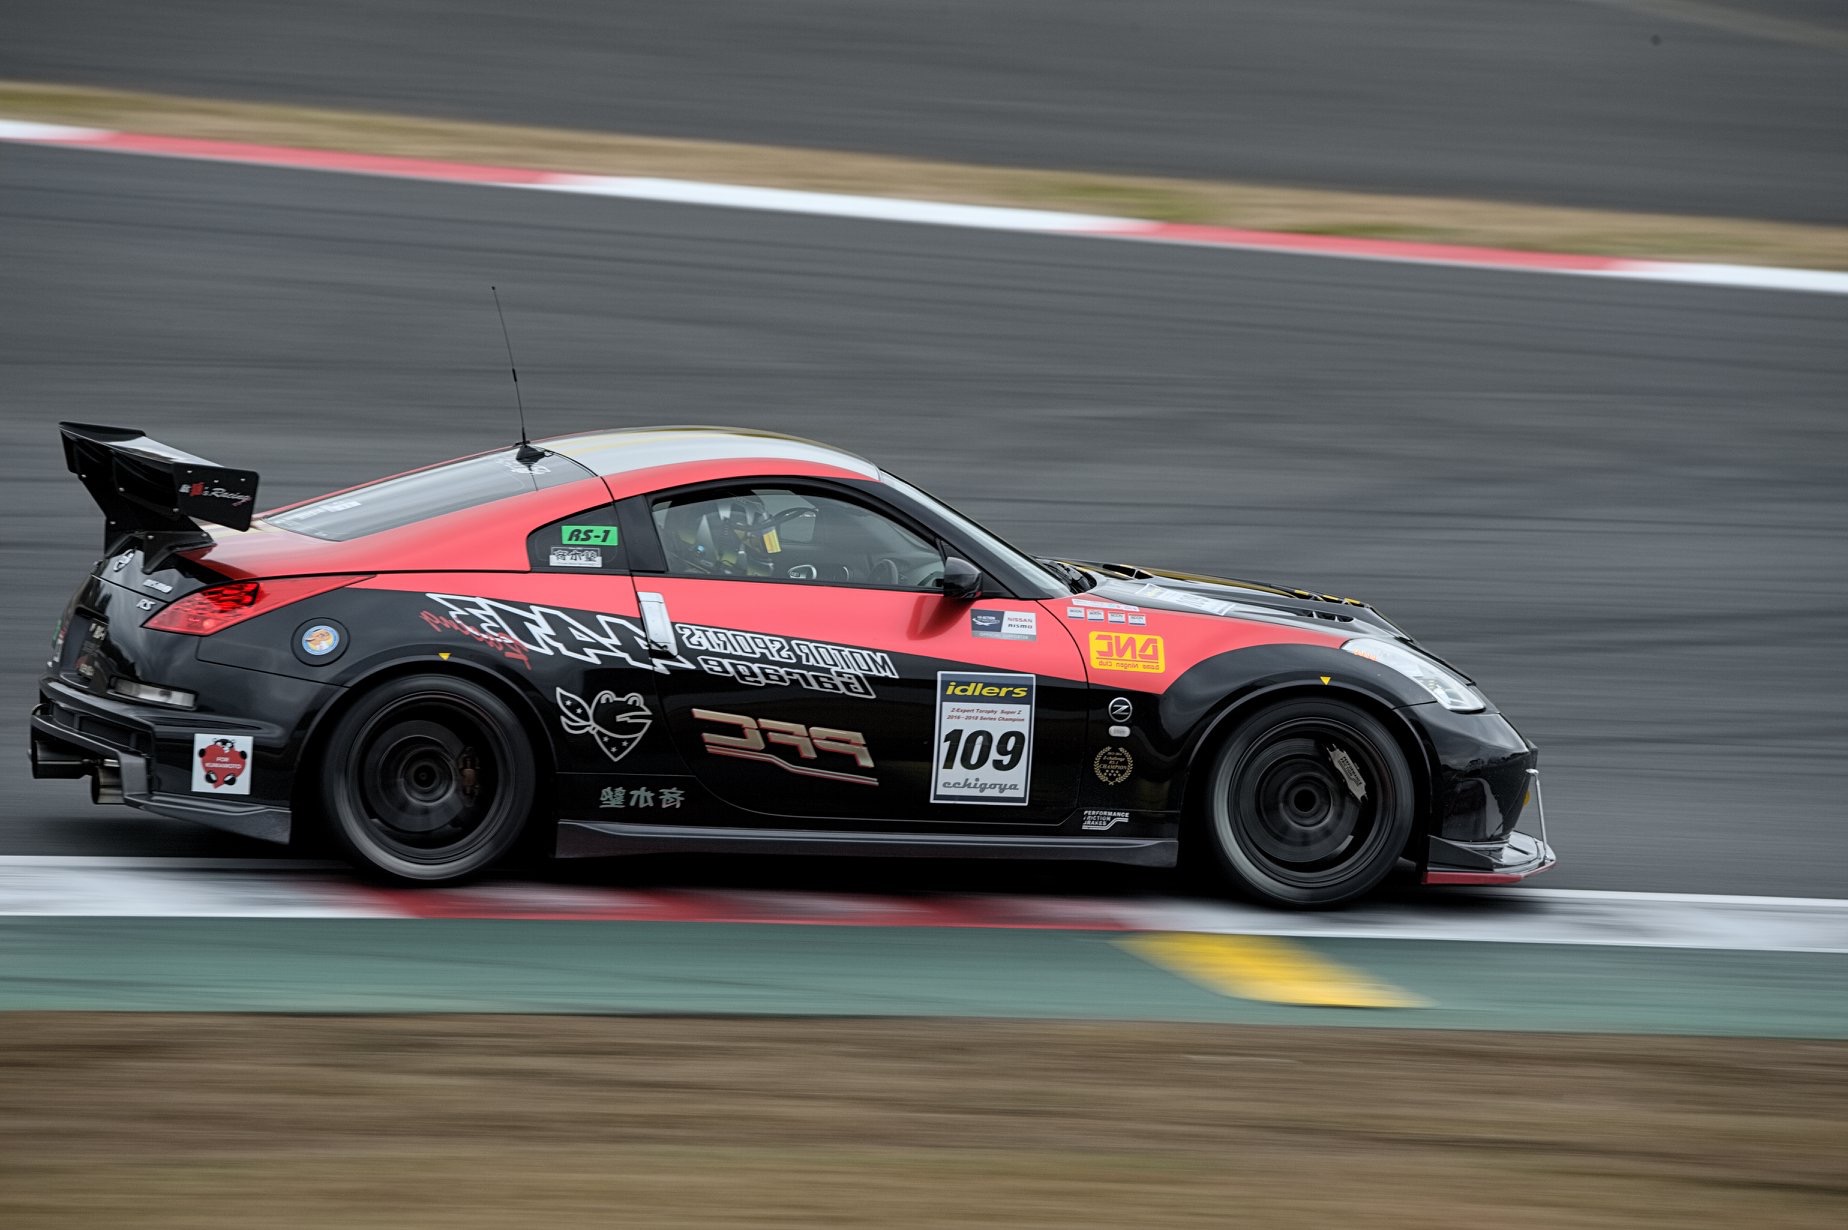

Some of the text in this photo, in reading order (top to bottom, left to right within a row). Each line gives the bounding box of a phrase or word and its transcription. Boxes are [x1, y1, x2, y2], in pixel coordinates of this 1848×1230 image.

[567, 528, 612, 543] RS-1
[945, 682, 1028, 698] idlers
[942, 728, 1026, 772] 109
